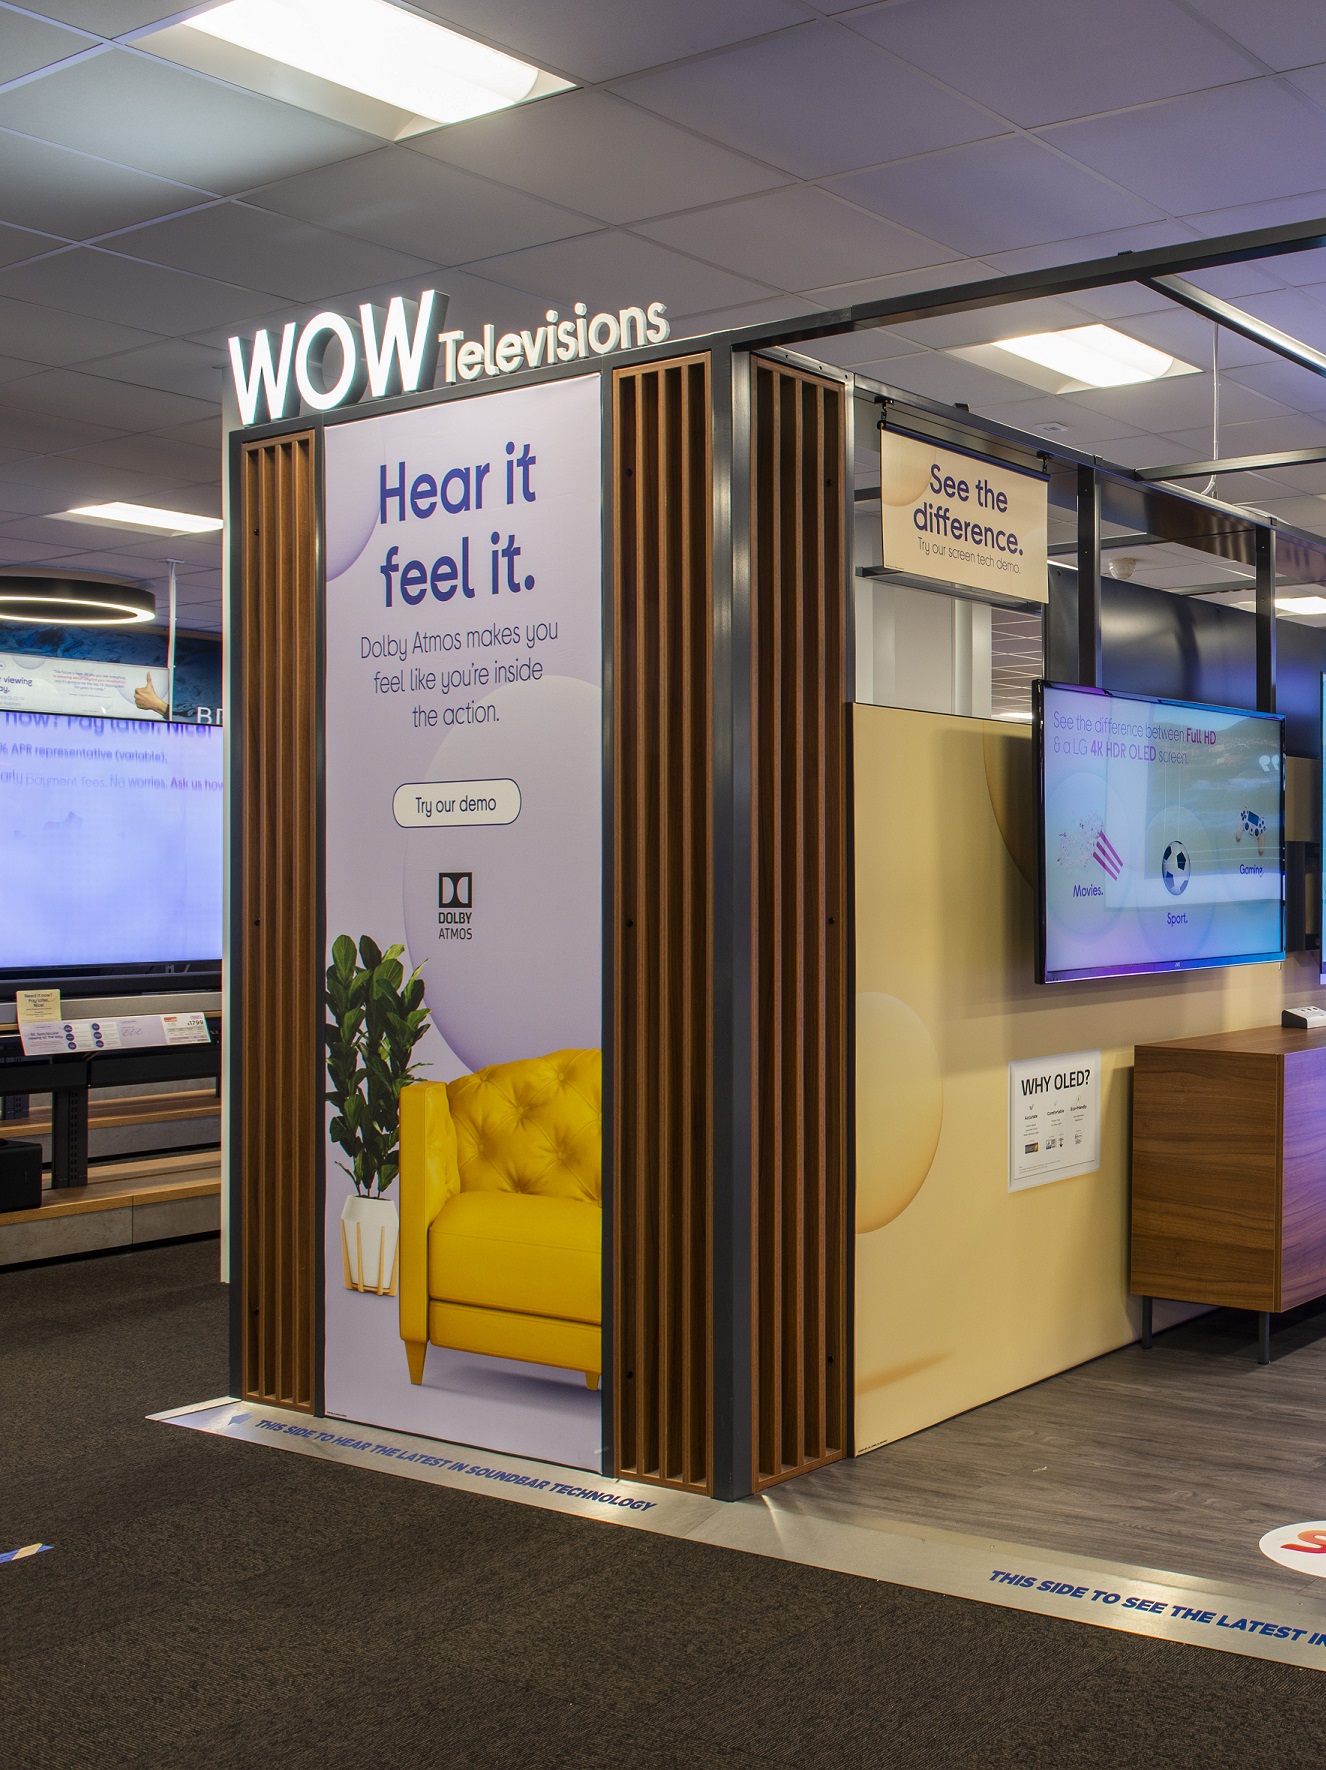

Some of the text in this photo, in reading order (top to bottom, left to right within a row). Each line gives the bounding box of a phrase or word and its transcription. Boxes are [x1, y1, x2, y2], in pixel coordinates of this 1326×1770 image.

[228, 289, 671, 426] WOW Televisions
[380, 441, 537, 525] Hear it
[930, 463, 1008, 513] See the
[913, 502, 1024, 556] difference.
[918, 536, 1021, 574] Try our screen tech demo.
[380, 531, 536, 608] feel it.
[361, 622, 558, 661] Dolby Atmos makes you
[3, 676, 33, 687] viewing
[373, 657, 543, 695] feel like you're inside
[412, 700, 500, 728] the action.
[1053, 711, 1217, 745] See the difference between Full HD
[11, 743, 32, 757] APR
[35, 746, 113, 761] representative
[1053, 736, 1188, 765] & a LG 4K HDR OLED screen.
[26, 773, 76, 791] payment
[81, 776, 105, 789] fees.
[109, 776, 126, 788] No
[171, 777, 189, 790] Ask
[192, 782, 202, 791] us
[415, 795, 497, 818] Try our demo
[1239, 863, 1265, 877] Gaming.
[1073, 884, 1104, 898] Movies.
[438, 912, 472, 924] DOLBY
[1167, 912, 1188, 927] Sport.
[438, 927, 472, 940] ATMOS
[1021, 1069, 1091, 1096] WHY OLED?
[1047, 1108, 1065, 1117] Comfortable
[254, 1419, 658, 1512] THIS SIDE TO HEAR THE LATEST IN SOUNDBAR TECHNOLOGY
[988, 1570, 1038, 1588] THIS
[1037, 1580, 1090, 1598] SIDE
[1091, 1590, 1121, 1604] TO
[1121, 1597, 1166, 1614] SEE
[1170, 1605, 1216, 1624] THE
[1215, 1615, 1308, 1641] LATEST
